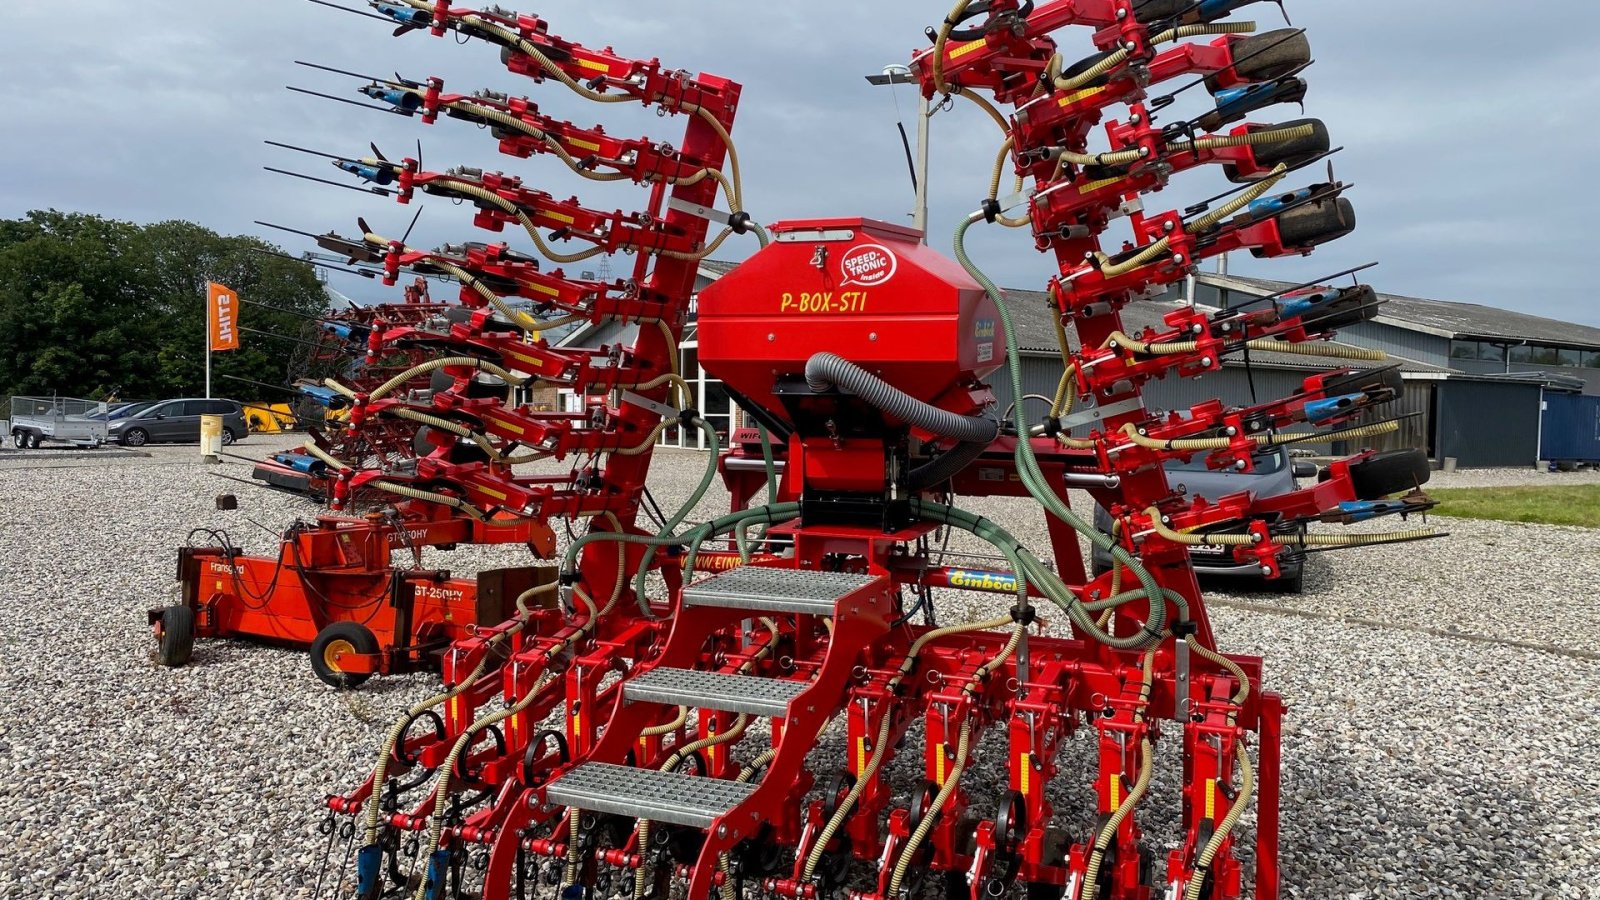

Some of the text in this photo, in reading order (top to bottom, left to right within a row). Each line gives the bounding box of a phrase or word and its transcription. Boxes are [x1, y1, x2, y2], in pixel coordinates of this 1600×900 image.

[844, 251, 881, 269] SPEED-
[850, 256, 887, 276] TRONIC
[860, 270, 885, 281] inside
[781, 291, 867, 312] P-BOX-STI
[414, 585, 463, 601] GT-250HY
